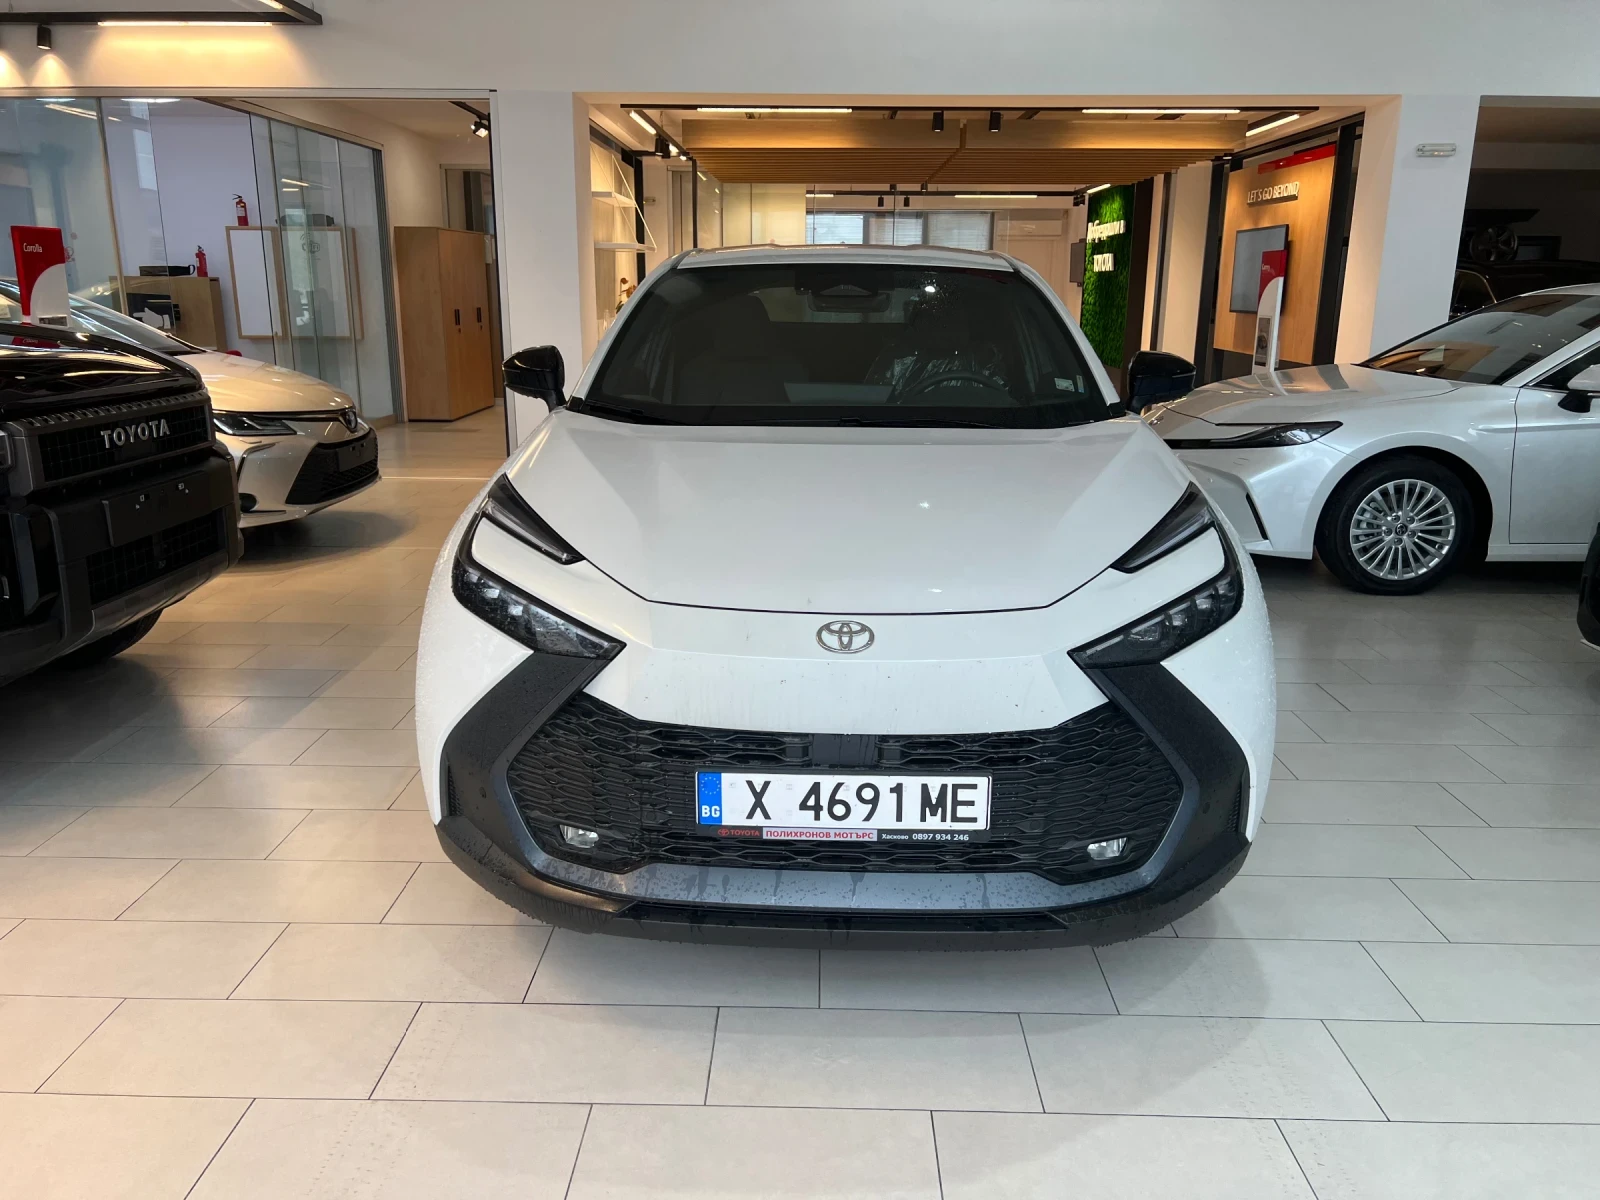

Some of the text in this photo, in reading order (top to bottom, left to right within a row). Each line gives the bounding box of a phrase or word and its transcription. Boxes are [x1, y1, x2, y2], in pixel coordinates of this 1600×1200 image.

[1247, 181, 1299, 203] LET'S GO BEYOND
[23, 243, 42, 252] Corolla
[1093, 253, 1114, 272] TOYOTA
[100, 418, 170, 449] TOYOTA
[745, 780, 978, 823] X 4691 ME
[701, 805, 720, 818] BG
[765, 830, 874, 840] ПОЛИХРОНОВ МОТЪРС
[881, 833, 909, 841] Хасково
